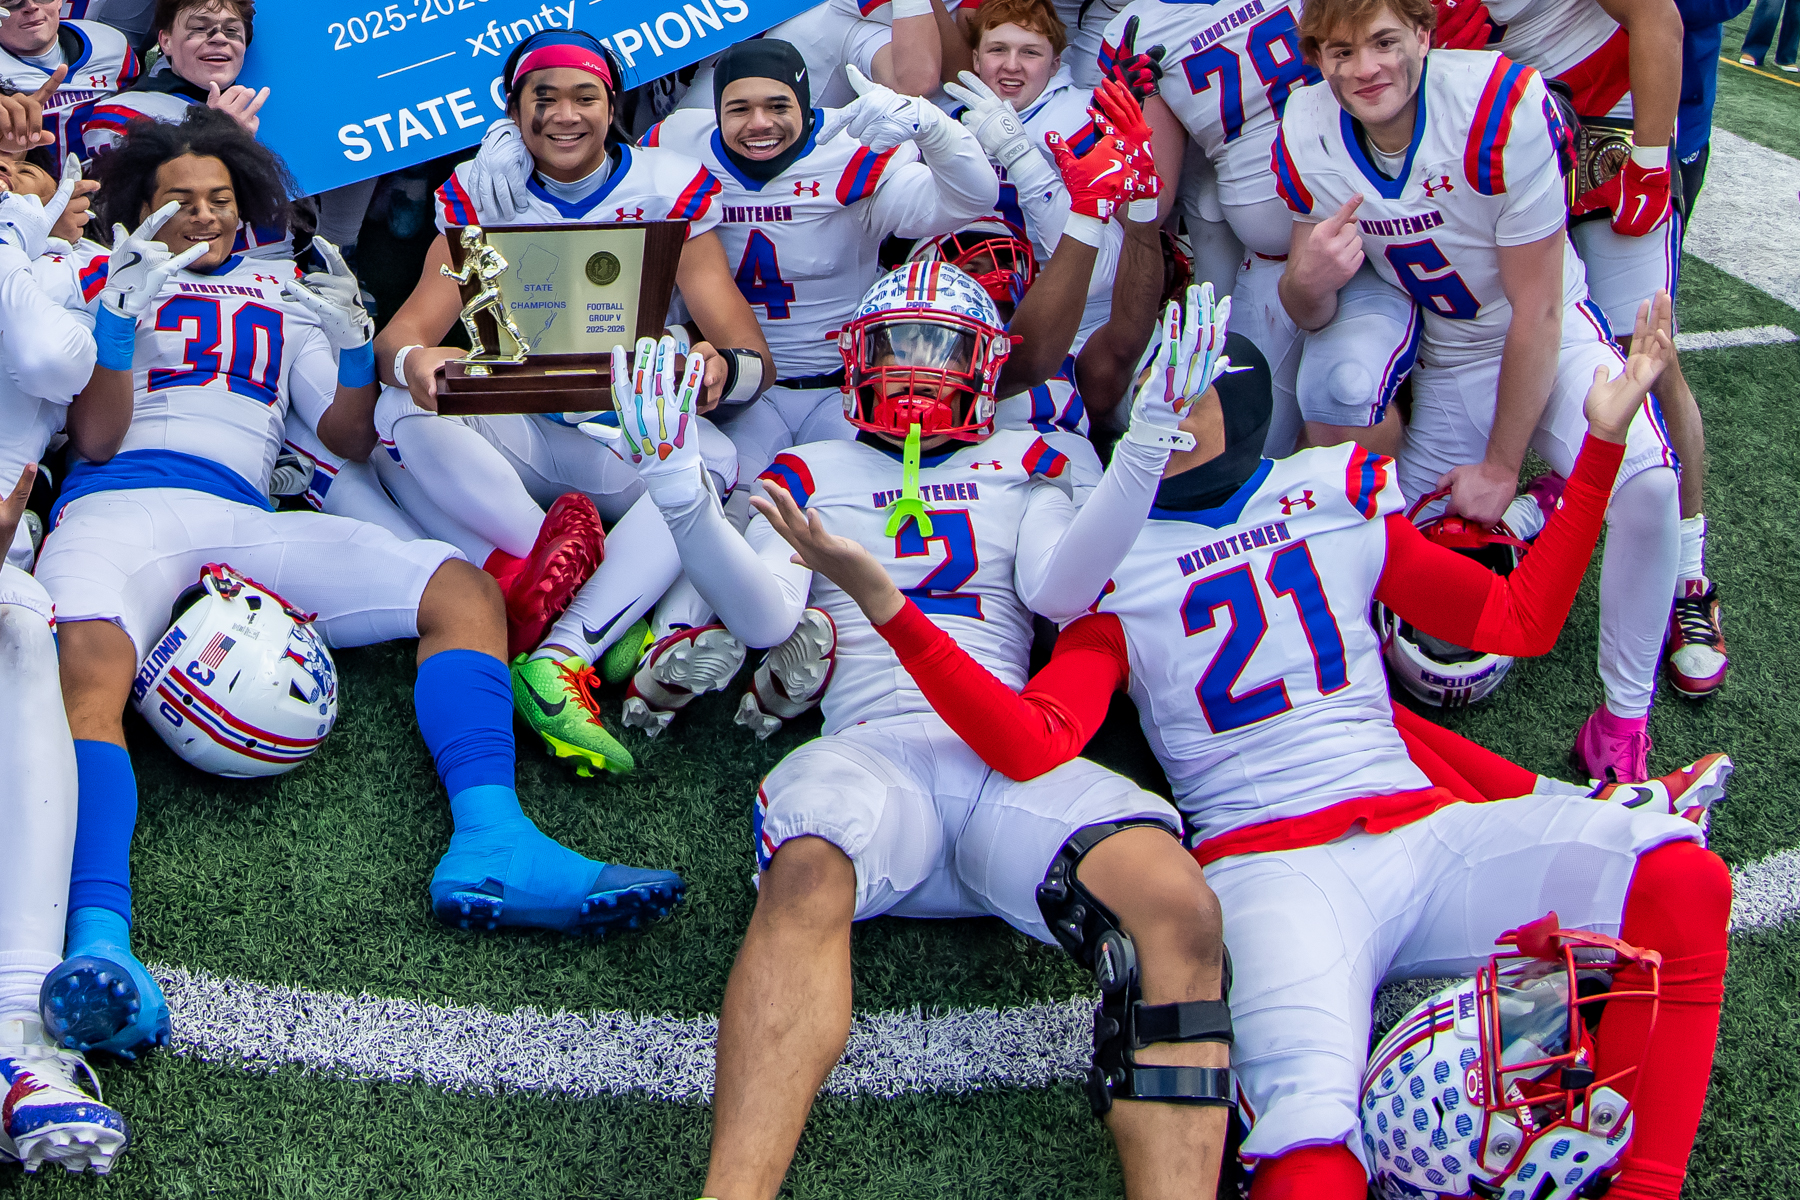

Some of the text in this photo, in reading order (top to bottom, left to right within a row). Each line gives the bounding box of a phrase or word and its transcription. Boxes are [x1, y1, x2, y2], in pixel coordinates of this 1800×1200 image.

[465, 0, 577, 59] xfinity
[1180, 5, 1325, 145] 78
[337, 86, 485, 163] STATE
[721, 205, 793, 223] INUTEMEN
[1359, 210, 1445, 236] MINUTEMEN
[179, 282, 265, 301] MINUTEMEN
[524, 284, 553, 292] STATE
[733, 229, 795, 322] 4
[1383, 237, 1483, 320] 6
[510, 301, 567, 310] CHAMPIONS
[586, 303, 624, 311] FOOTBALL
[588, 313, 621, 322] GROUP V
[147, 293, 285, 407] 30
[586, 325, 625, 333] 2025-2026
[897, 508, 985, 621] 2
[1177, 520, 1291, 578] MINUTEMEN
[1179, 540, 1349, 735] 21
[1459, 990, 1475, 1021] PRIDE
